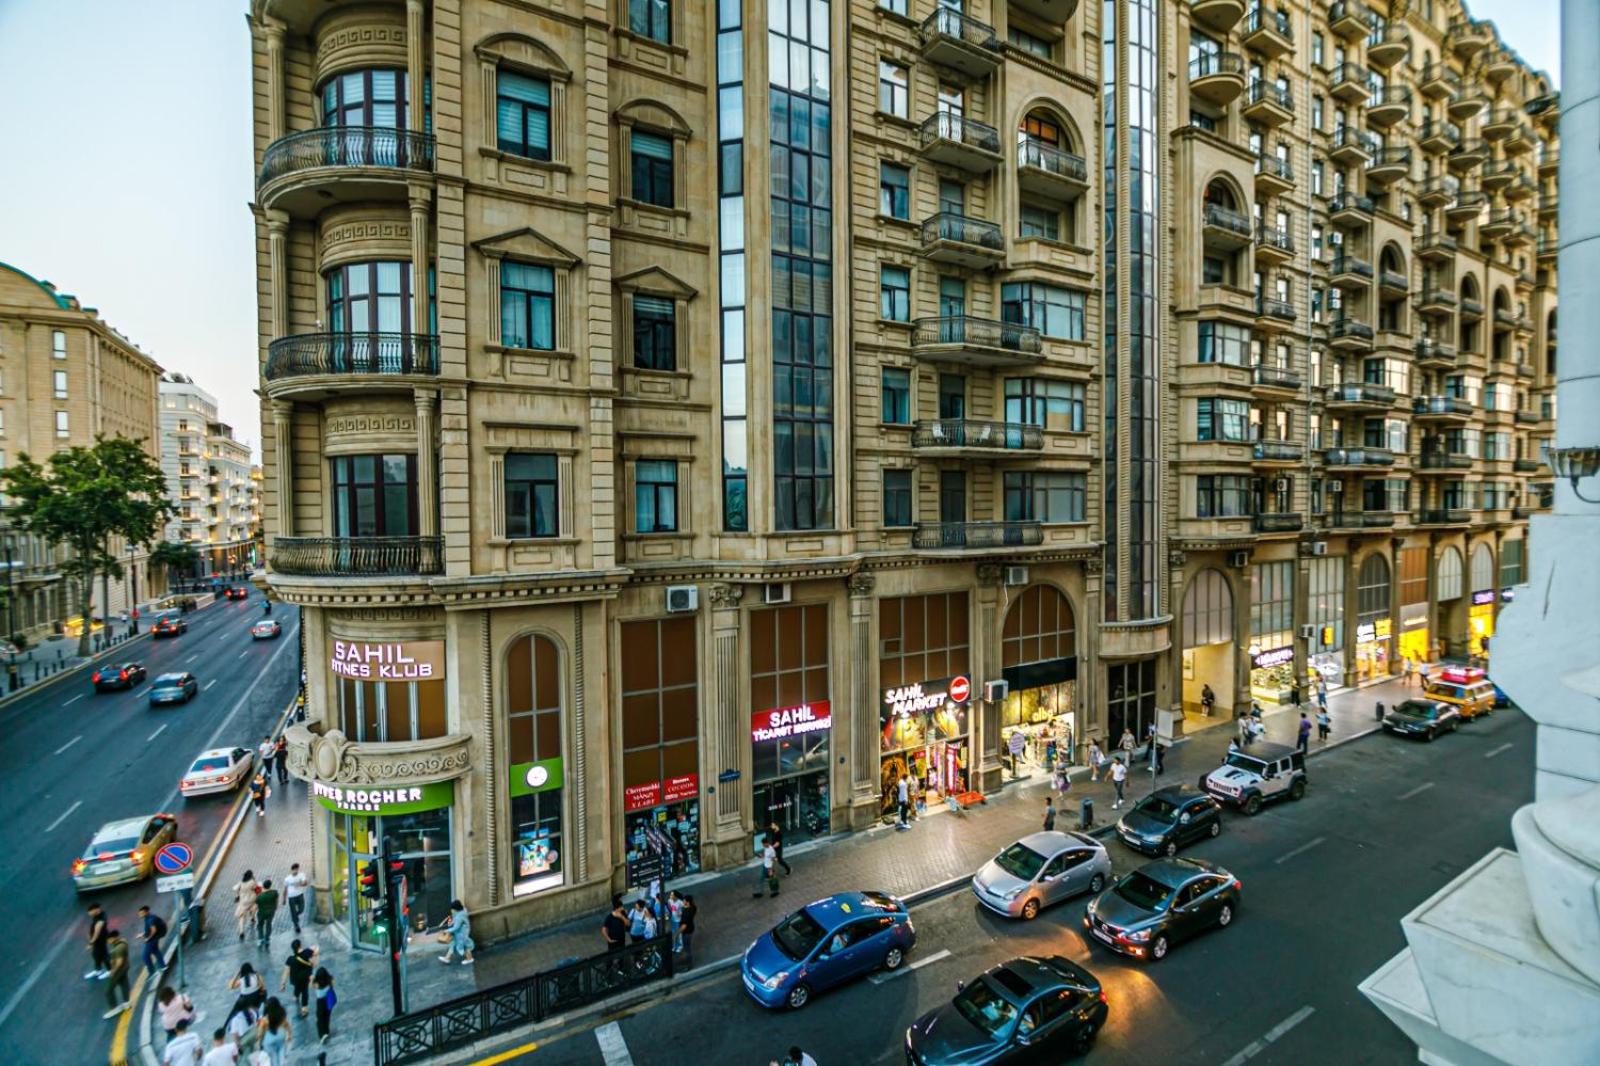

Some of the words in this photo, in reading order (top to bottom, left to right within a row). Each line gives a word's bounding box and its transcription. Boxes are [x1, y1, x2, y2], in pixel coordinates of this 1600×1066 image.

[379, 664, 432, 677] KLUB
[891, 692, 948, 716] MARKET
[346, 788, 422, 804] ROCHER
